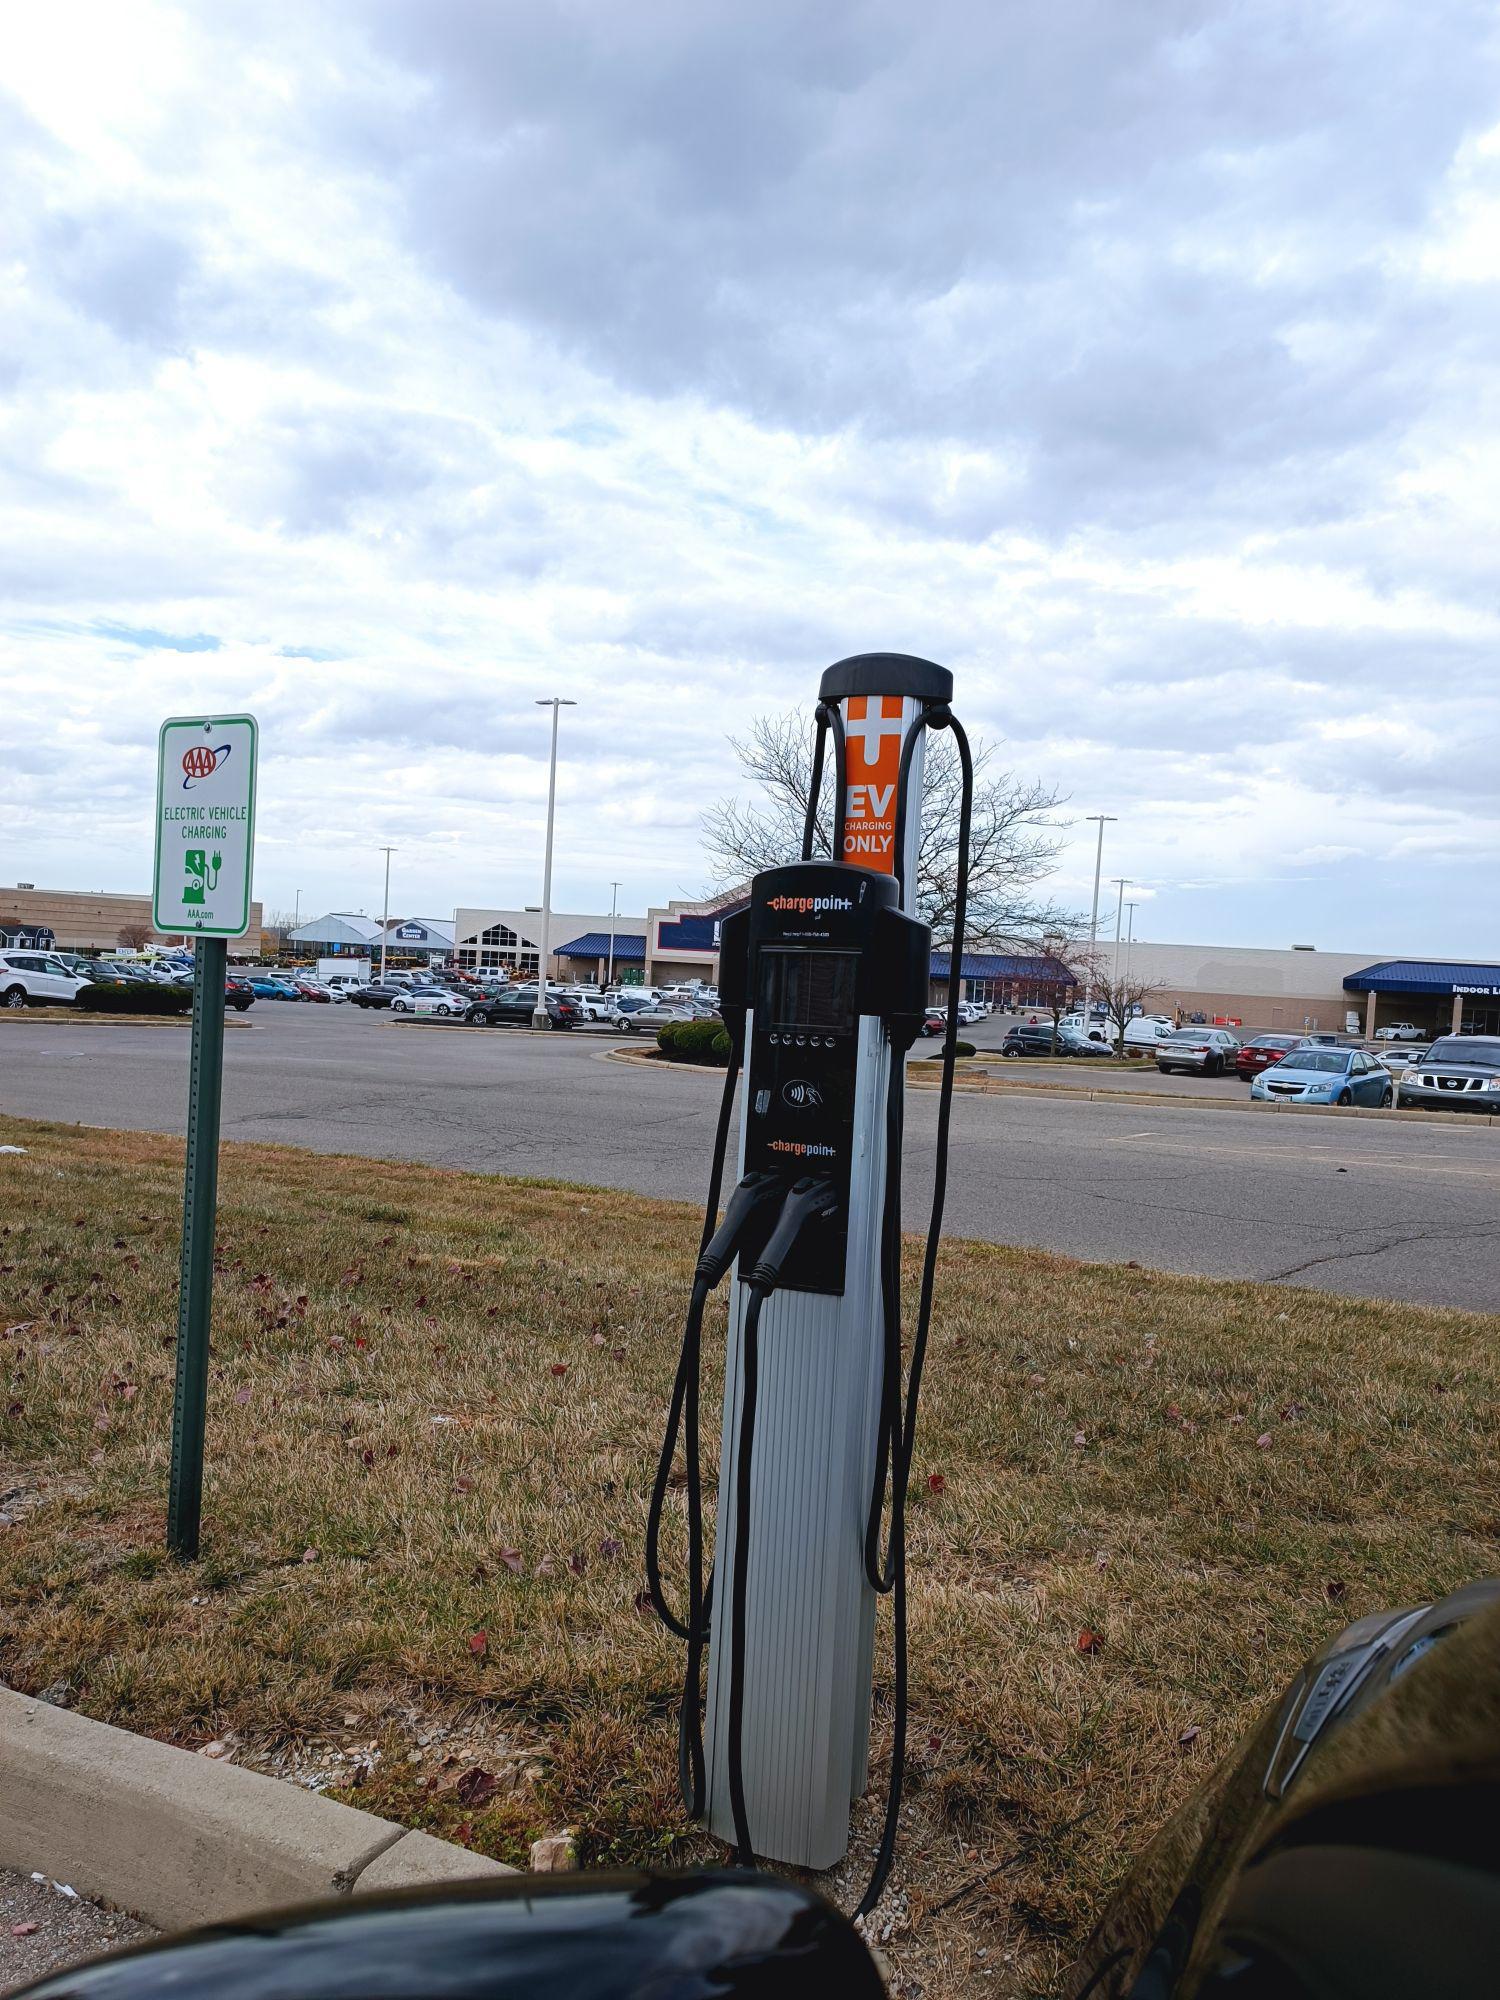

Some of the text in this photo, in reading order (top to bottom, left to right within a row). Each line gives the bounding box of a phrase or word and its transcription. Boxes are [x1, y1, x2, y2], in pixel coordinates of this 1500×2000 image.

[184, 747, 216, 778] AAA
[846, 784, 896, 818] EV
[164, 806, 247, 821] ELECTRIC VEHICLE
[181, 825, 227, 839] CHARGING
[845, 821, 892, 831] CHARGING
[844, 835, 893, 853] ONLY
[187, 908, 214, 919] AAA.com
[1452, 984, 1490, 994] INDOOR
